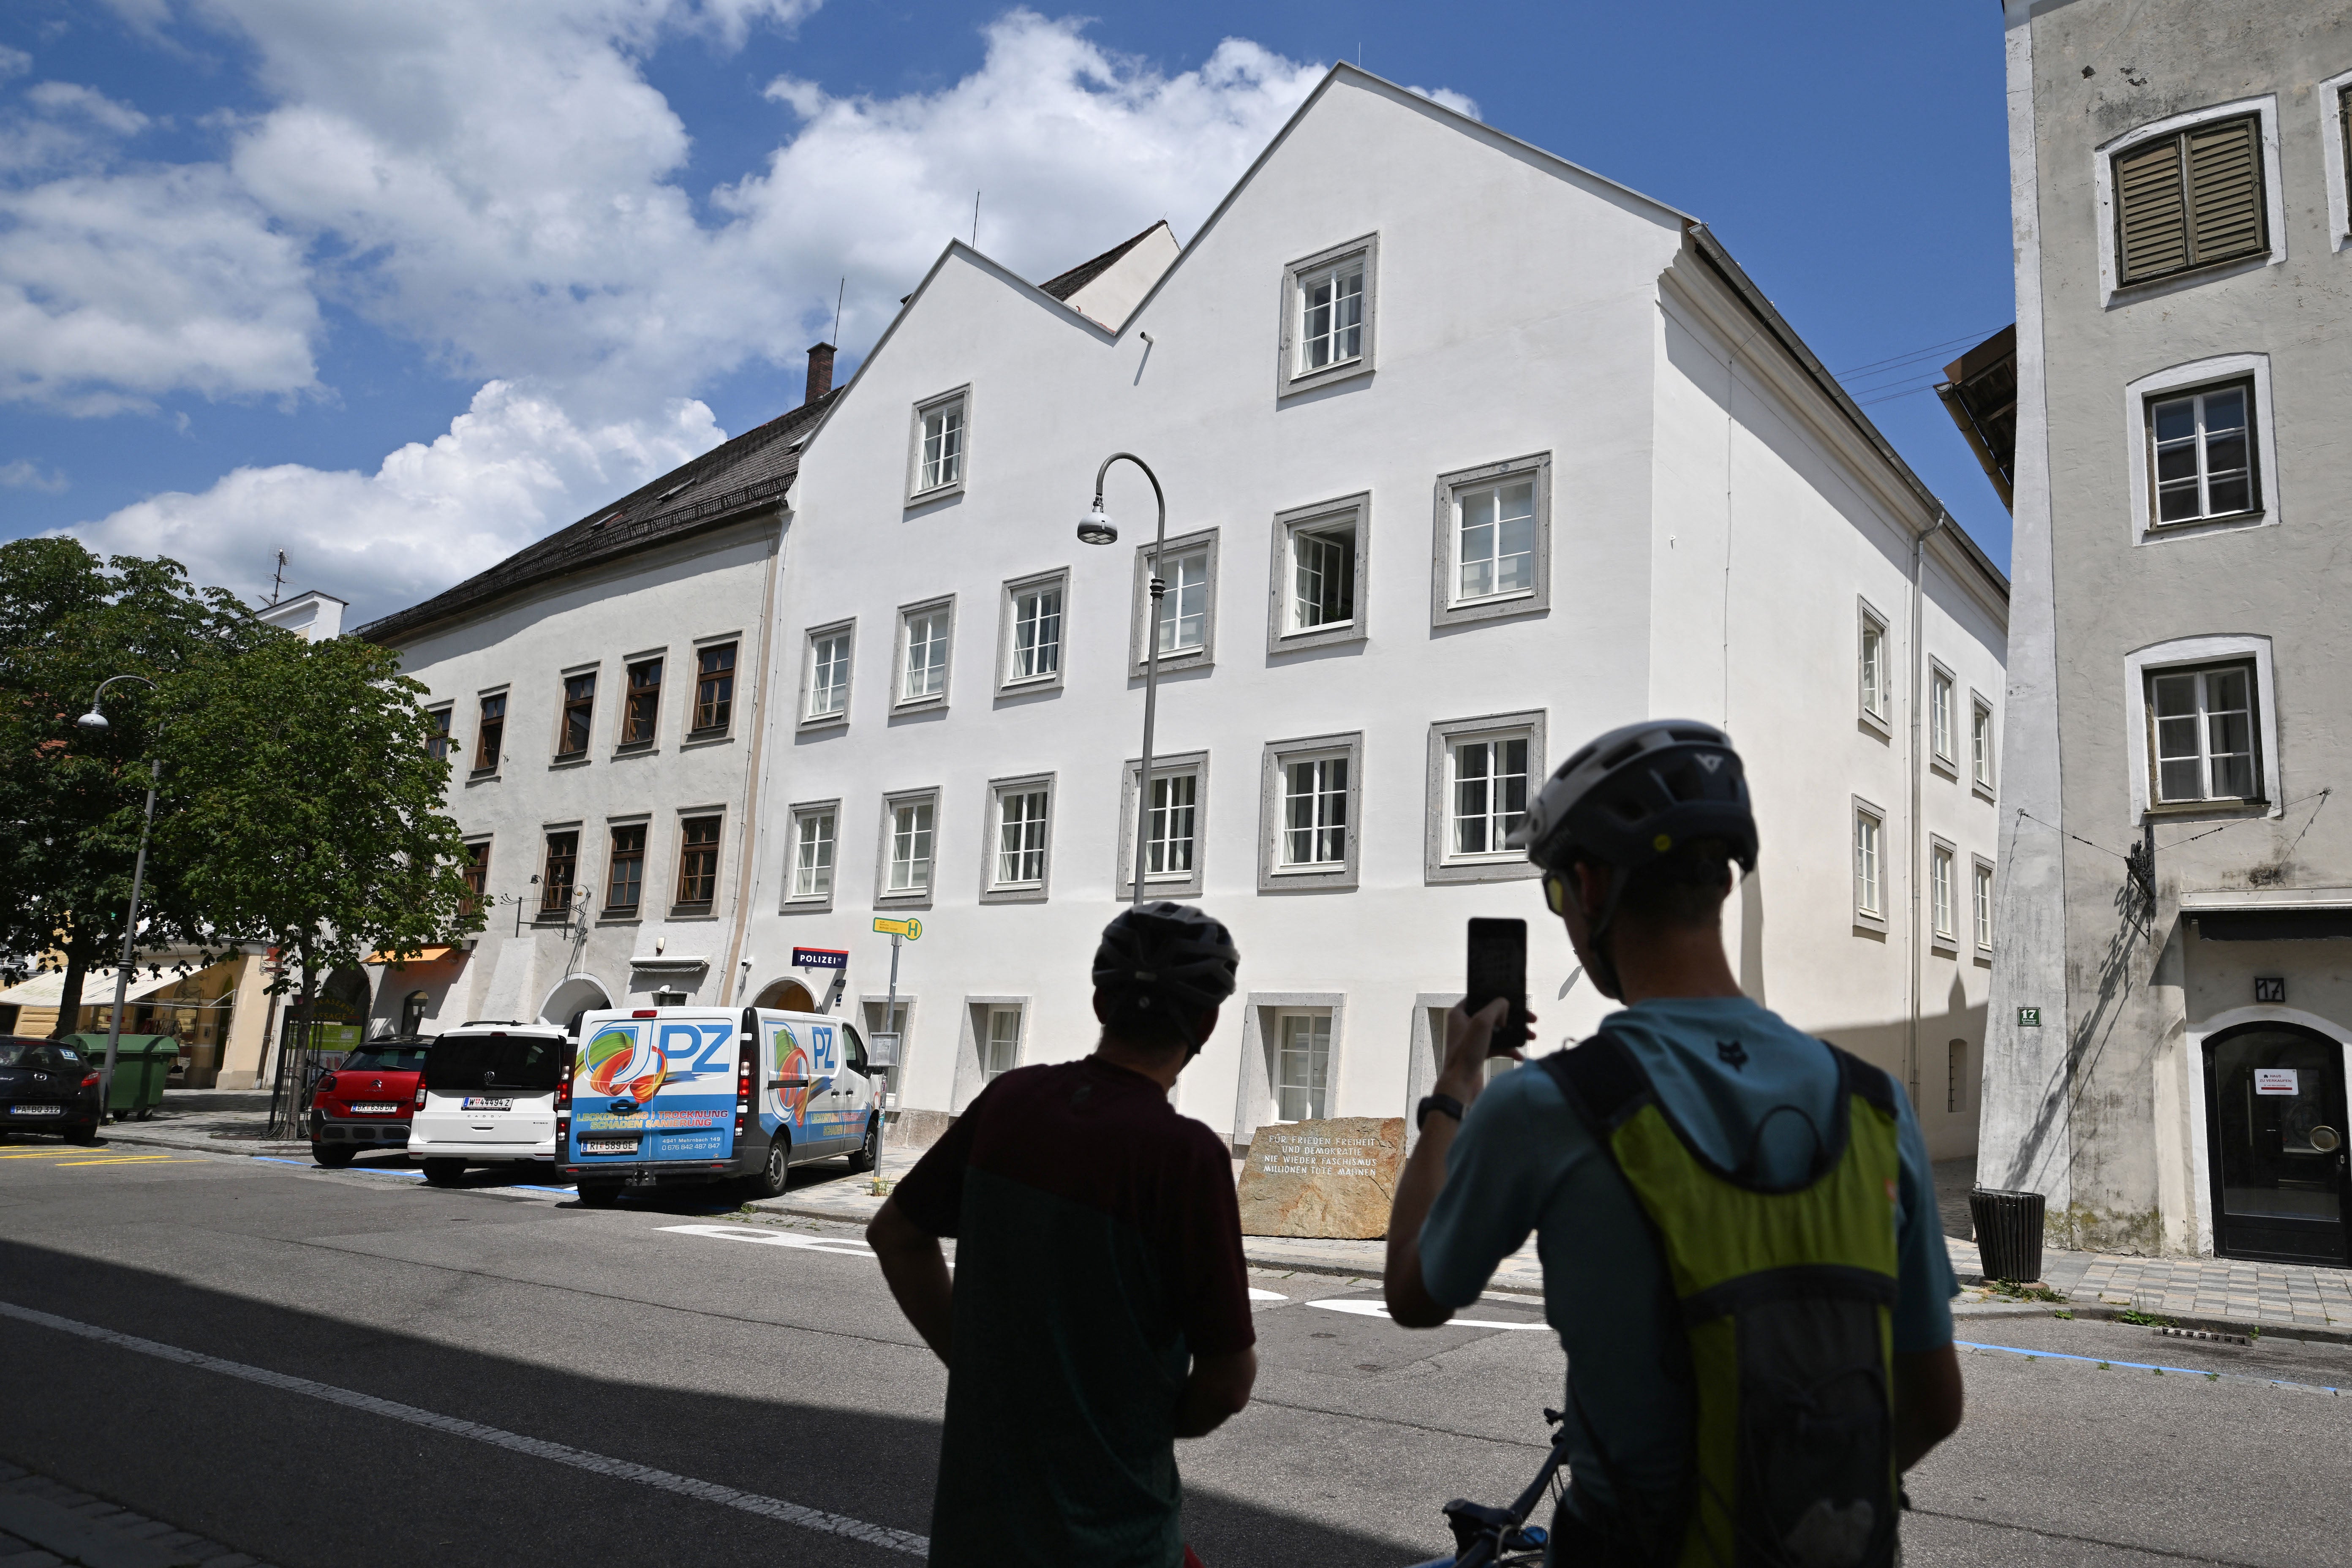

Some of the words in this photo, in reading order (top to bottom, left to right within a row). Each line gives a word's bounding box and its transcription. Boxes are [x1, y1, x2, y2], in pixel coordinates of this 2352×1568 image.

[908, 922, 918, 936] H
[800, 955, 836, 964] POLIZEI
[2257, 979, 2281, 1001] 17
[2021, 1010, 2036, 1018] 17
[576, 1111, 649, 1122] LECKORTUNG
[658, 1110, 729, 1119] TROCKNUNG
[811, 1113, 840, 1124] LECKORTUNG
[590, 1120, 643, 1130] SCHADEN
[645, 1119, 712, 1127] SANIERUNG
[1269, 1133, 1287, 1143] FÜR
[1292, 1136, 1331, 1144] FRIEDEN
[1336, 1138, 1375, 1146] FREIHEIT
[590, 1141, 598, 1150] RI
[605, 1141, 620, 1149] 589
[623, 1141, 633, 1149] GE
[1304, 1146, 1362, 1156] DEMOKRATIE
[1283, 1156, 1316, 1164] WIEDER
[1322, 1157, 1376, 1166] FASCHISMUS
[1263, 1165, 1307, 1173] MILLIONEN
[1311, 1166, 1332, 1175] TOTE
[1338, 1168, 1376, 1176] MAHNEN
